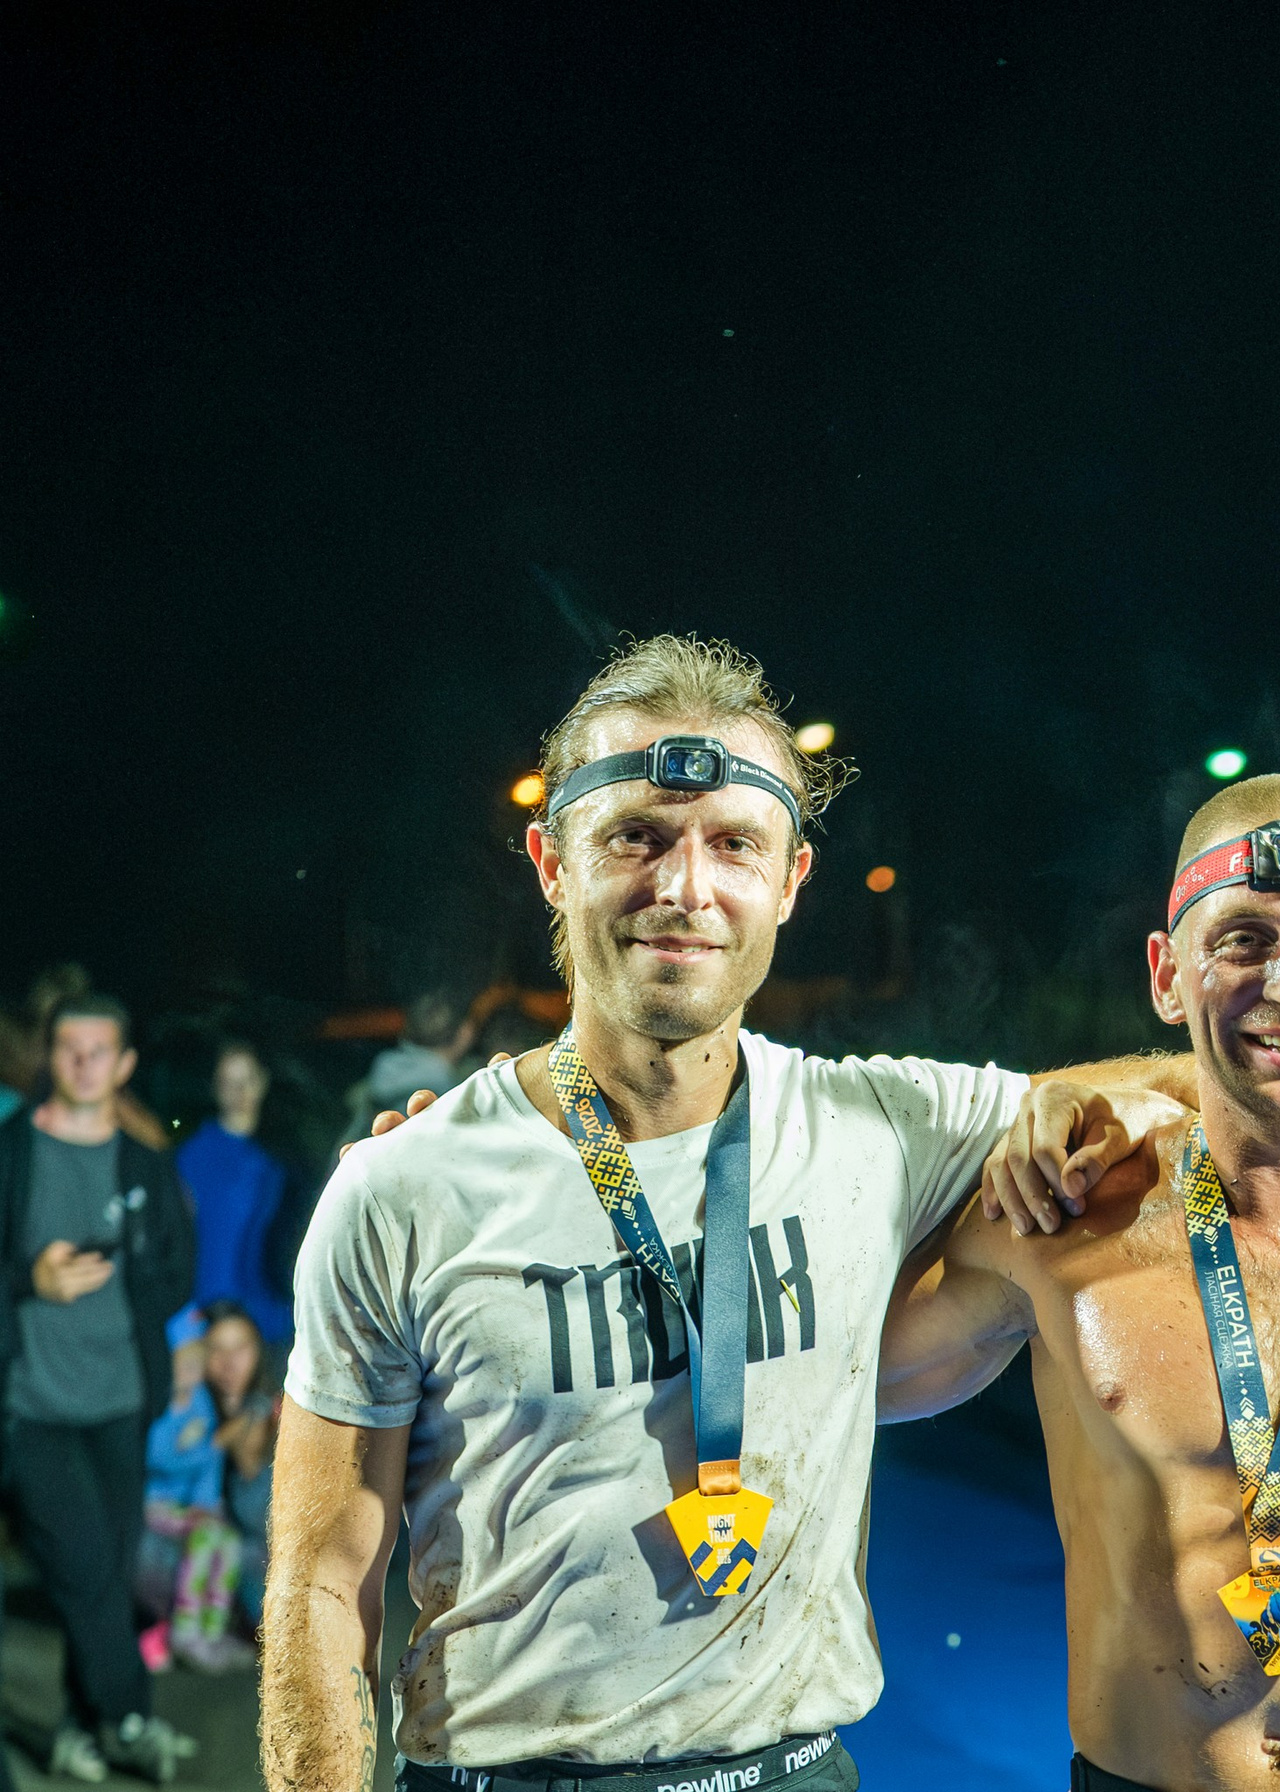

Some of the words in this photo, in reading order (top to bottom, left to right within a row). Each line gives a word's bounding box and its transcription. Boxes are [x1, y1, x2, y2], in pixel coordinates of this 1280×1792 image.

[740, 764, 759, 776] Black
[575, 1098, 603, 1139] 2026
[1217, 1264, 1255, 1368] ELKPATH
[707, 1513, 736, 1529] NIGHT
[708, 1529, 736, 1544] TRAIL
